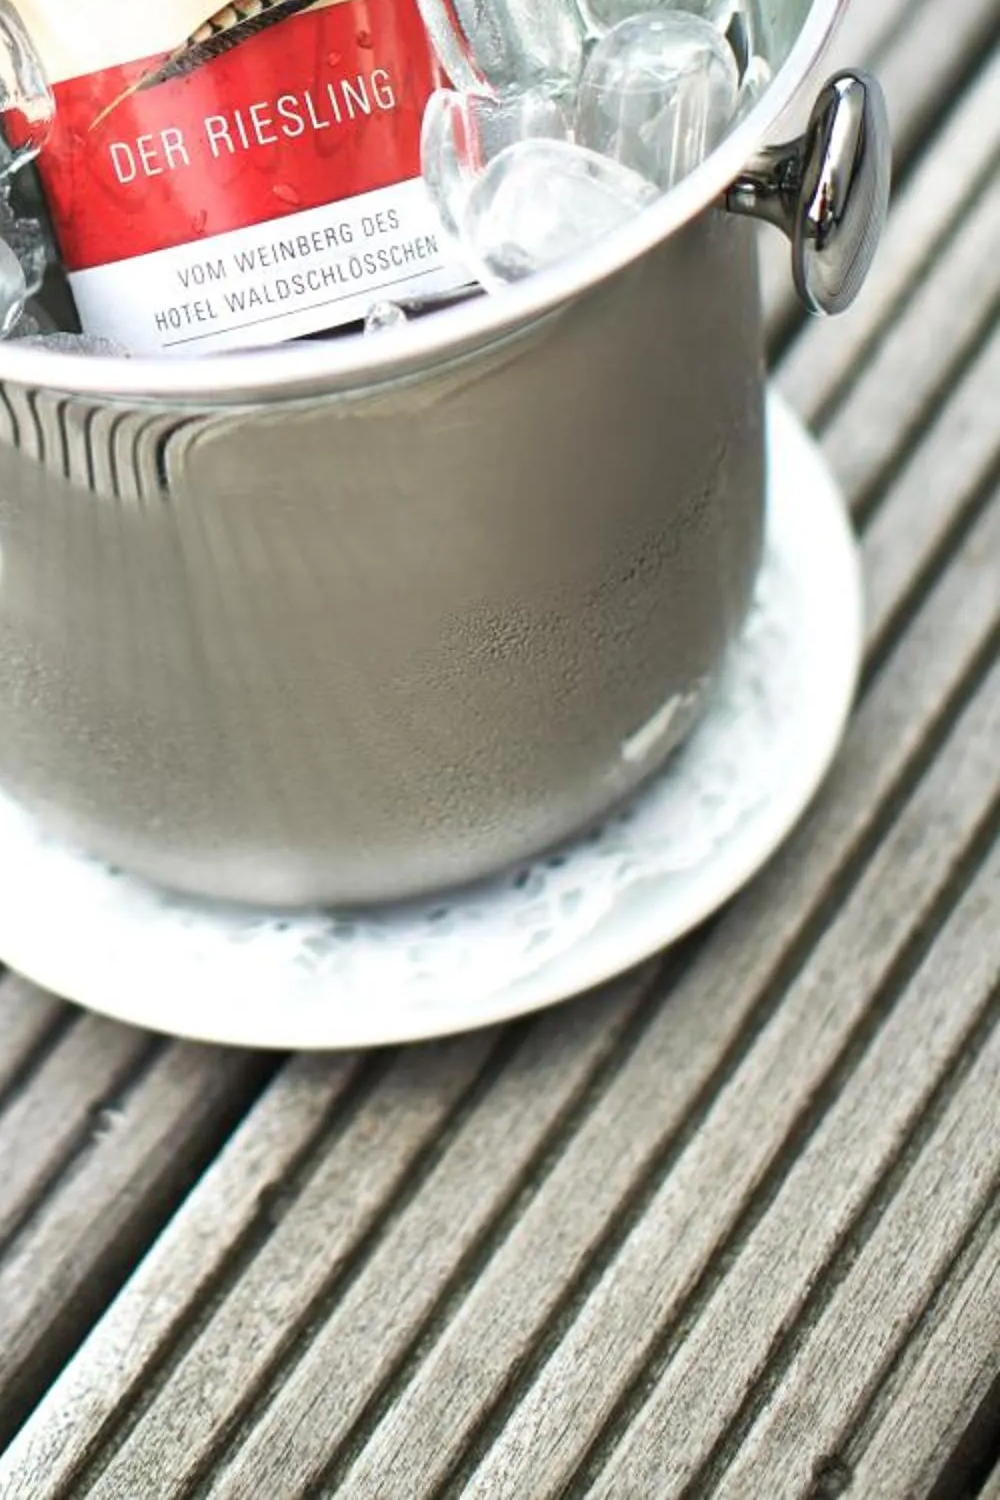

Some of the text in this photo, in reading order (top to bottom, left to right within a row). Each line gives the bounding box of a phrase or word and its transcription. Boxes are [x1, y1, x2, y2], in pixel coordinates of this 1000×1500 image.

[109, 69, 396, 184] DER RIESLING
[177, 208, 400, 289] VOM WEINBERG DES
[154, 300, 217, 332] HOTEL
